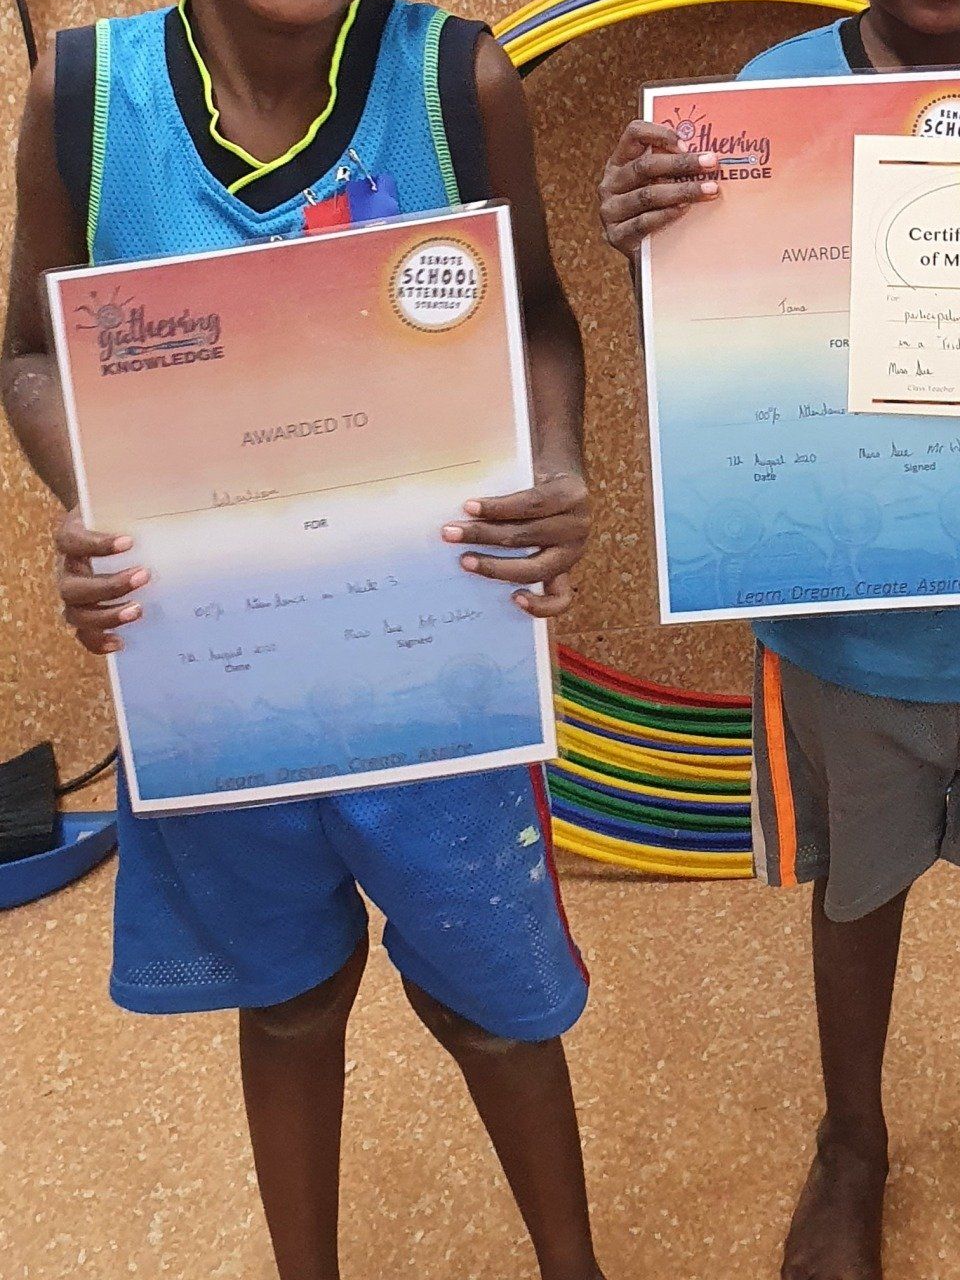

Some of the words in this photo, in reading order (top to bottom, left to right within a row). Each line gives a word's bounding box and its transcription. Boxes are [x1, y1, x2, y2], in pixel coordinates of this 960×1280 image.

[782, 246, 850, 263] AWARDE
[920, 252, 940, 266] of
[402, 268, 476, 285] SCHOOL
[98, 304, 221, 361] gathering
[829, 339, 849, 348] FOR
[100, 346, 225, 376] KNOWLEDGE
[241, 417, 338, 447] AWARDED
[342, 412, 369, 428] TO
[904, 462, 936, 472] Signed
[754, 473, 776, 481] Date
[303, 519, 329, 530] FOR
[736, 589, 785, 605] Learn,
[791, 586, 849, 601] Dream,
[855, 581, 911, 596] Create,
